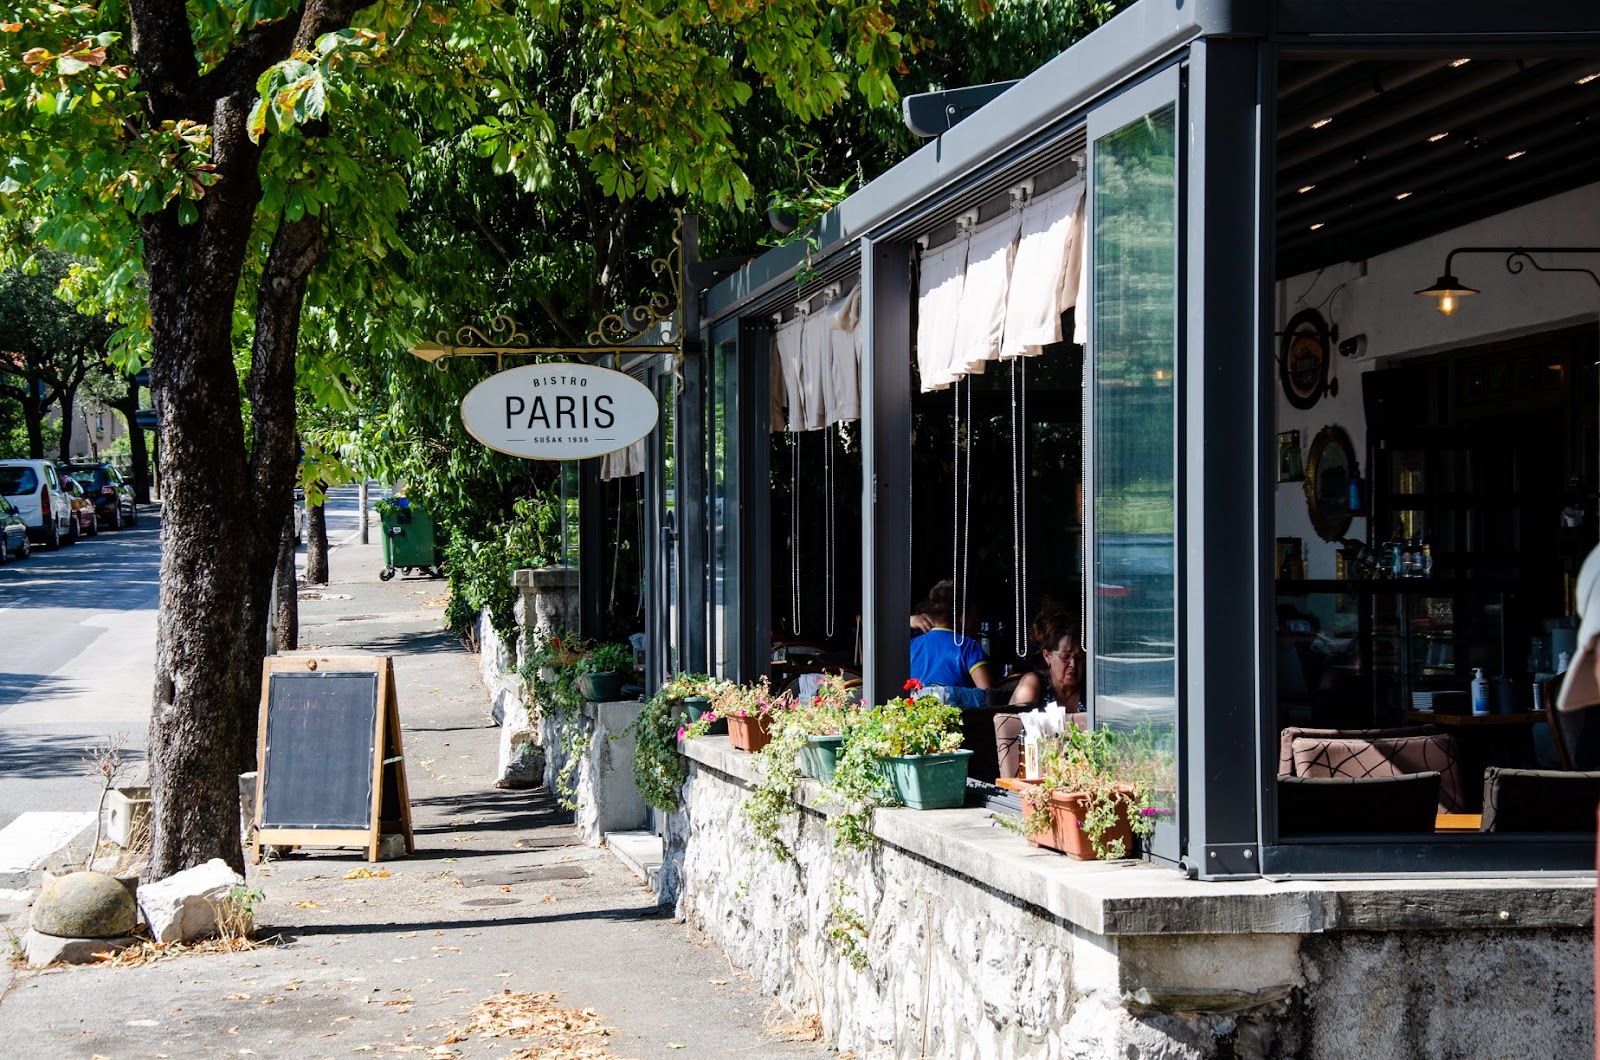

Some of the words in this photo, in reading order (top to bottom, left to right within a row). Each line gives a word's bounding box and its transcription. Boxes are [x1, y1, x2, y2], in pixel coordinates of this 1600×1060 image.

[533, 376, 588, 387] BISTRO
[506, 395, 615, 429] PARIS
[534, 436, 563, 444] SUŠAK
